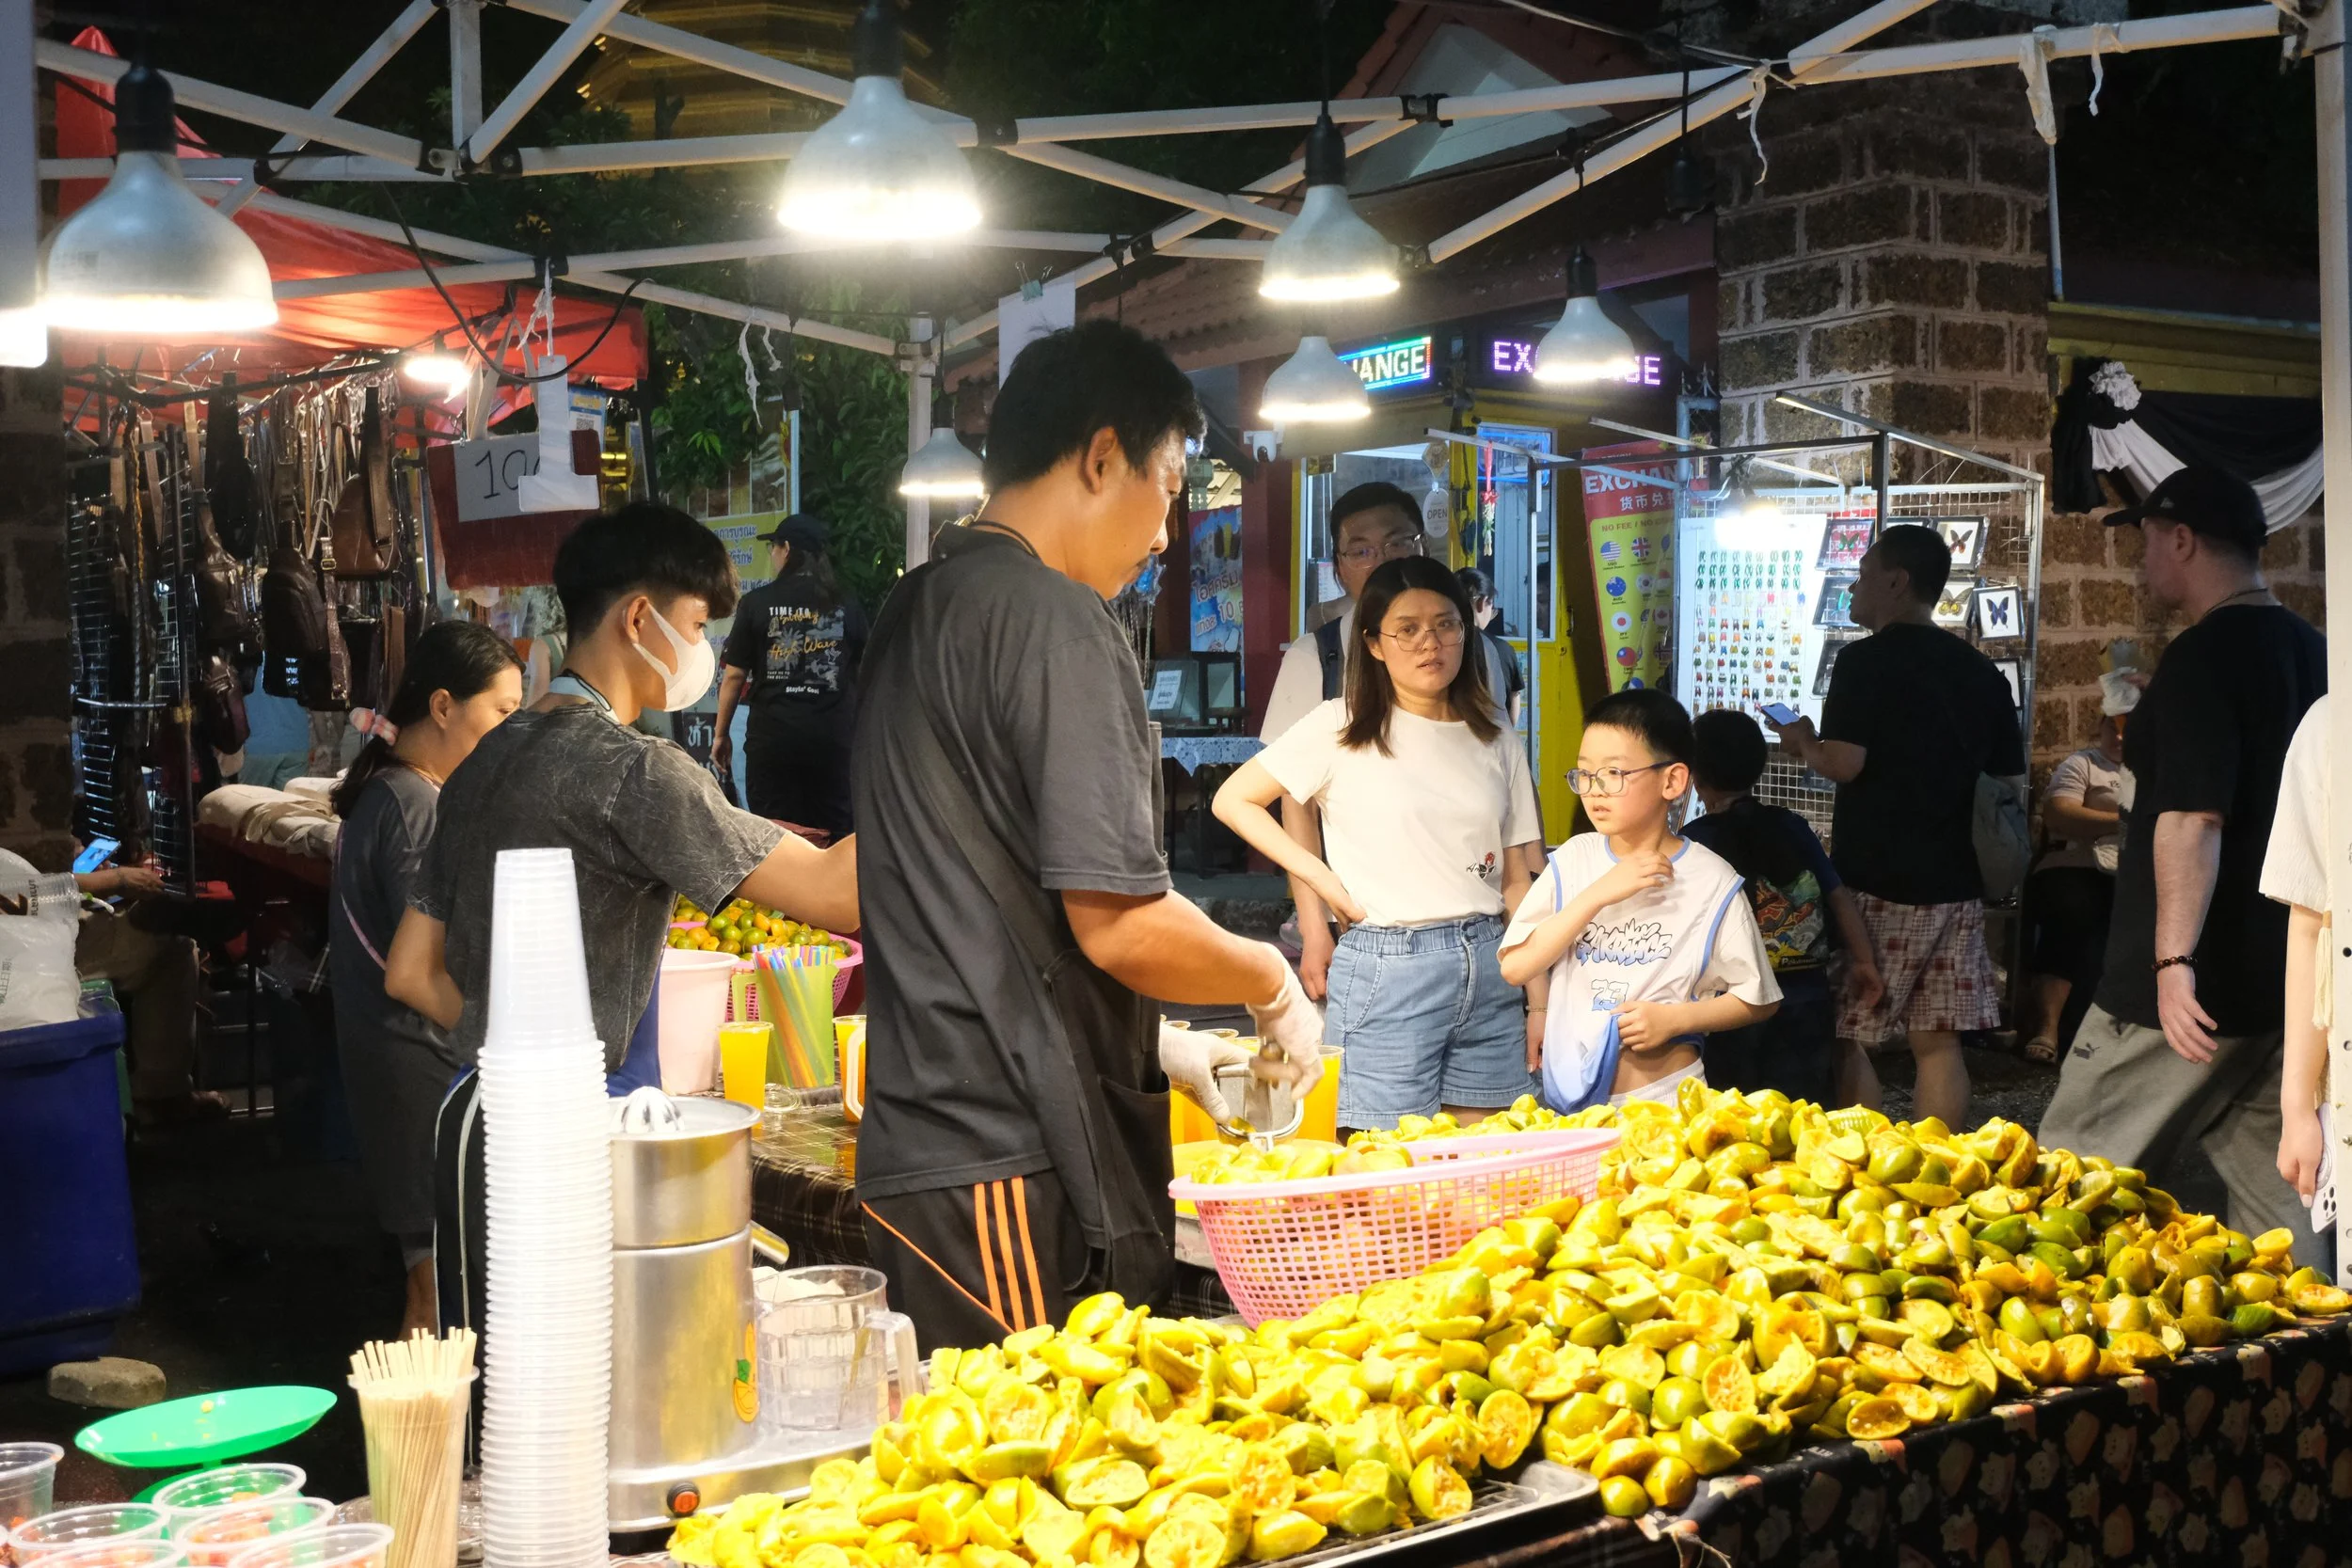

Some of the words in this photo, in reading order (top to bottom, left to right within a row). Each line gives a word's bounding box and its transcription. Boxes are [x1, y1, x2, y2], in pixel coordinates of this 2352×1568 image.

[1426, 508, 1447, 520] OPEN
[1601, 524, 1615, 532] NO
[1616, 522, 1632, 531] FEE
[769, 607, 793, 616] TIME
[798, 607, 810, 617] TO
[1591, 979, 1629, 1012] 23
